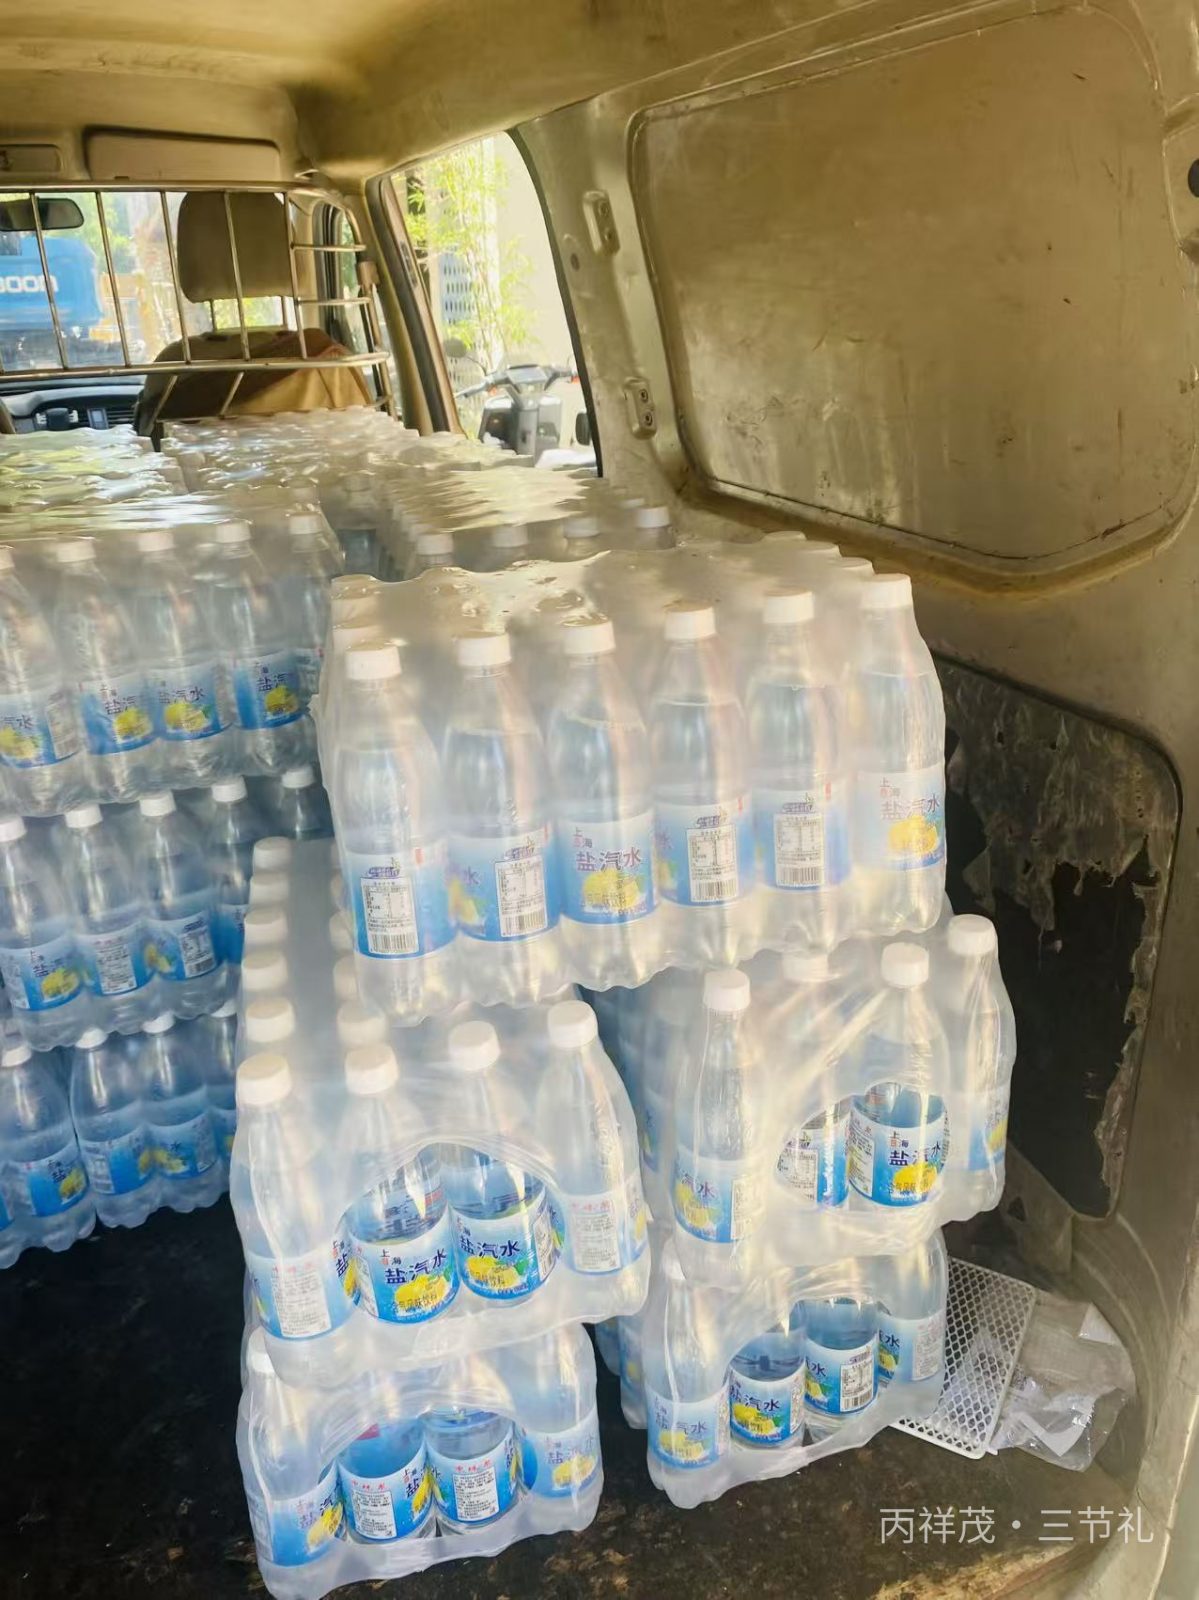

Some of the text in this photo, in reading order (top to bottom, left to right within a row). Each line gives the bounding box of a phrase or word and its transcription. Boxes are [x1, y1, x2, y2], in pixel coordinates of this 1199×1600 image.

[576, 846, 642, 873] 盐汽水
[459, 1238, 520, 1259] 盐汽水
[384, 1247, 448, 1286] 盐汽水
